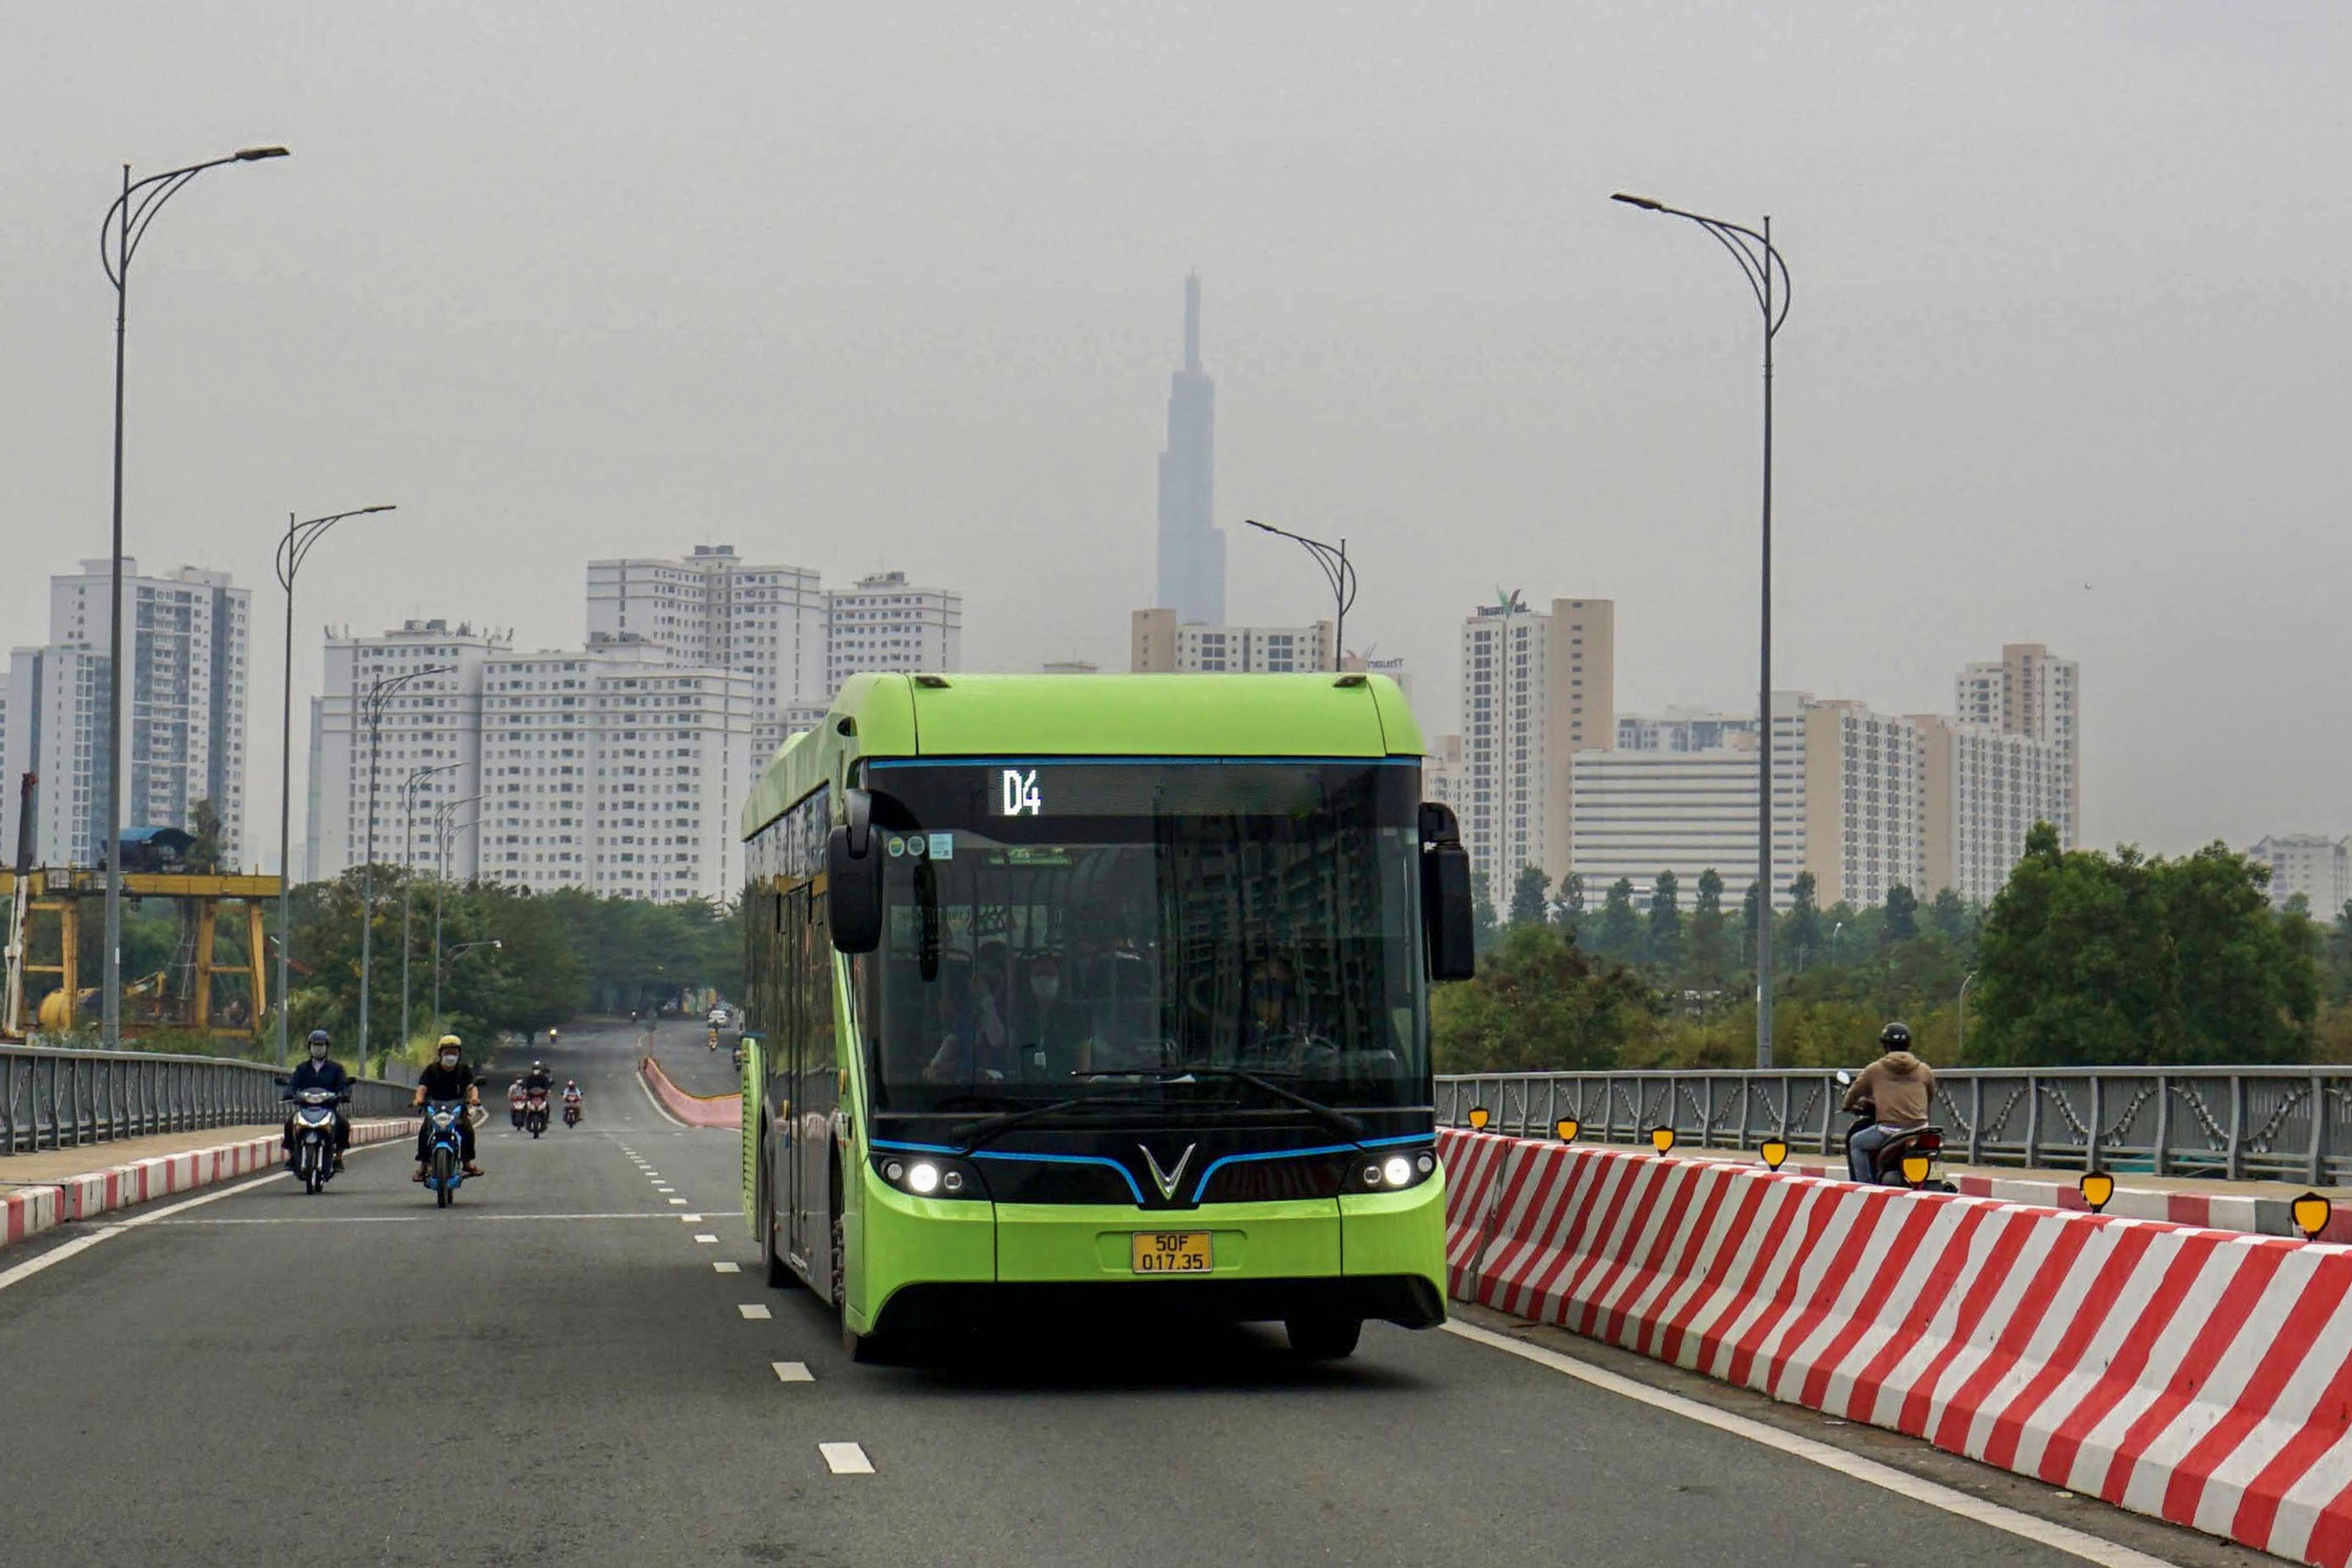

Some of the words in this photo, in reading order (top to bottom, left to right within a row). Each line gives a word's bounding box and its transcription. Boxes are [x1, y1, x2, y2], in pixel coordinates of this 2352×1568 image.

[1003, 770, 1041, 815] D4
[1156, 1235, 1188, 1251] 50F
[1142, 1254, 1203, 1269] 017.35
